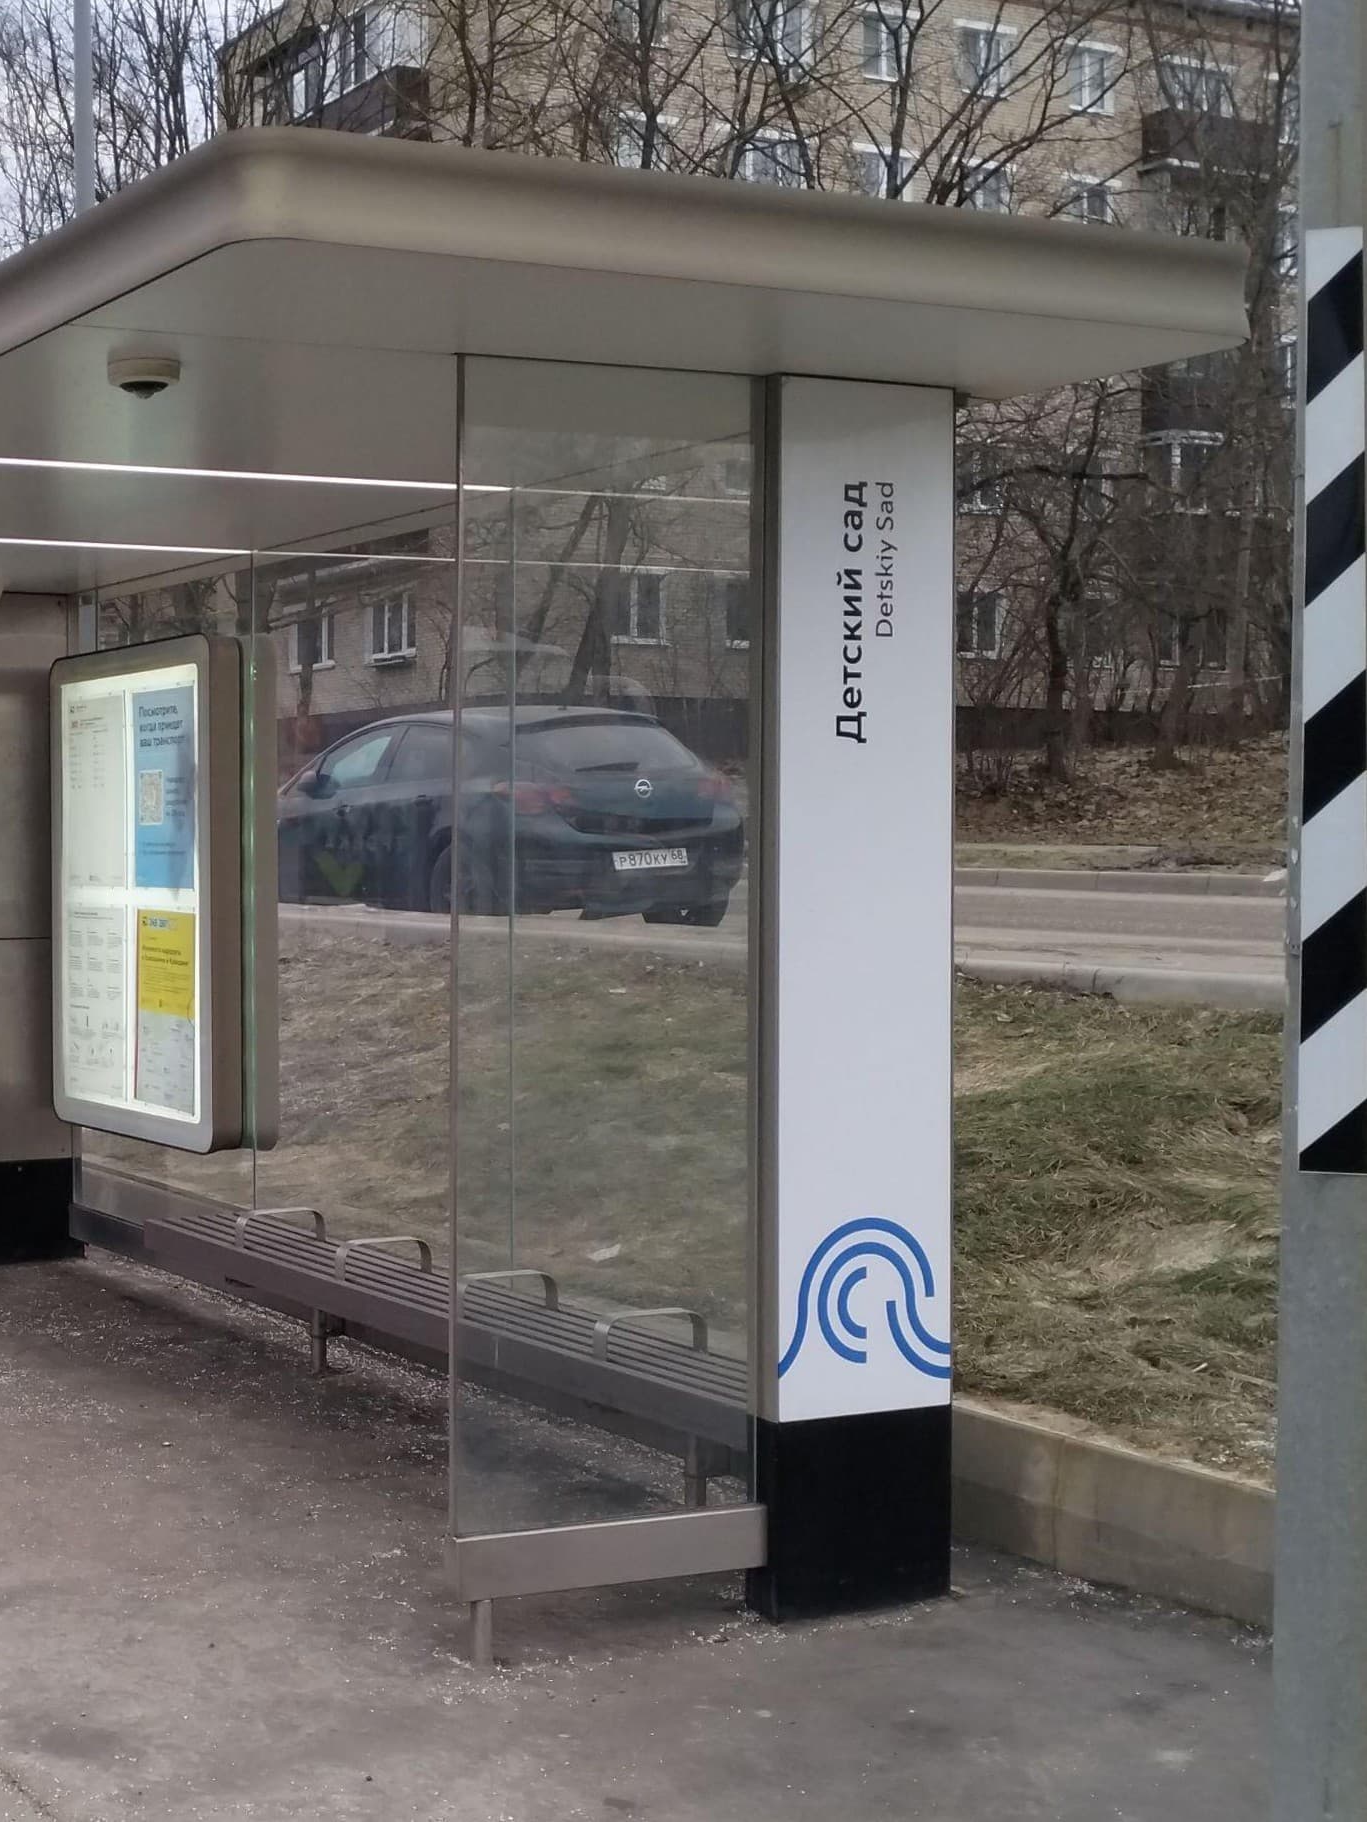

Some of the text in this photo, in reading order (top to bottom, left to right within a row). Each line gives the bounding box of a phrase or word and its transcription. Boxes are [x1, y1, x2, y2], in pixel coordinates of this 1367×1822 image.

[836, 480, 868, 744] Детский сад
[874, 481, 898, 637] Detskiy Sad
